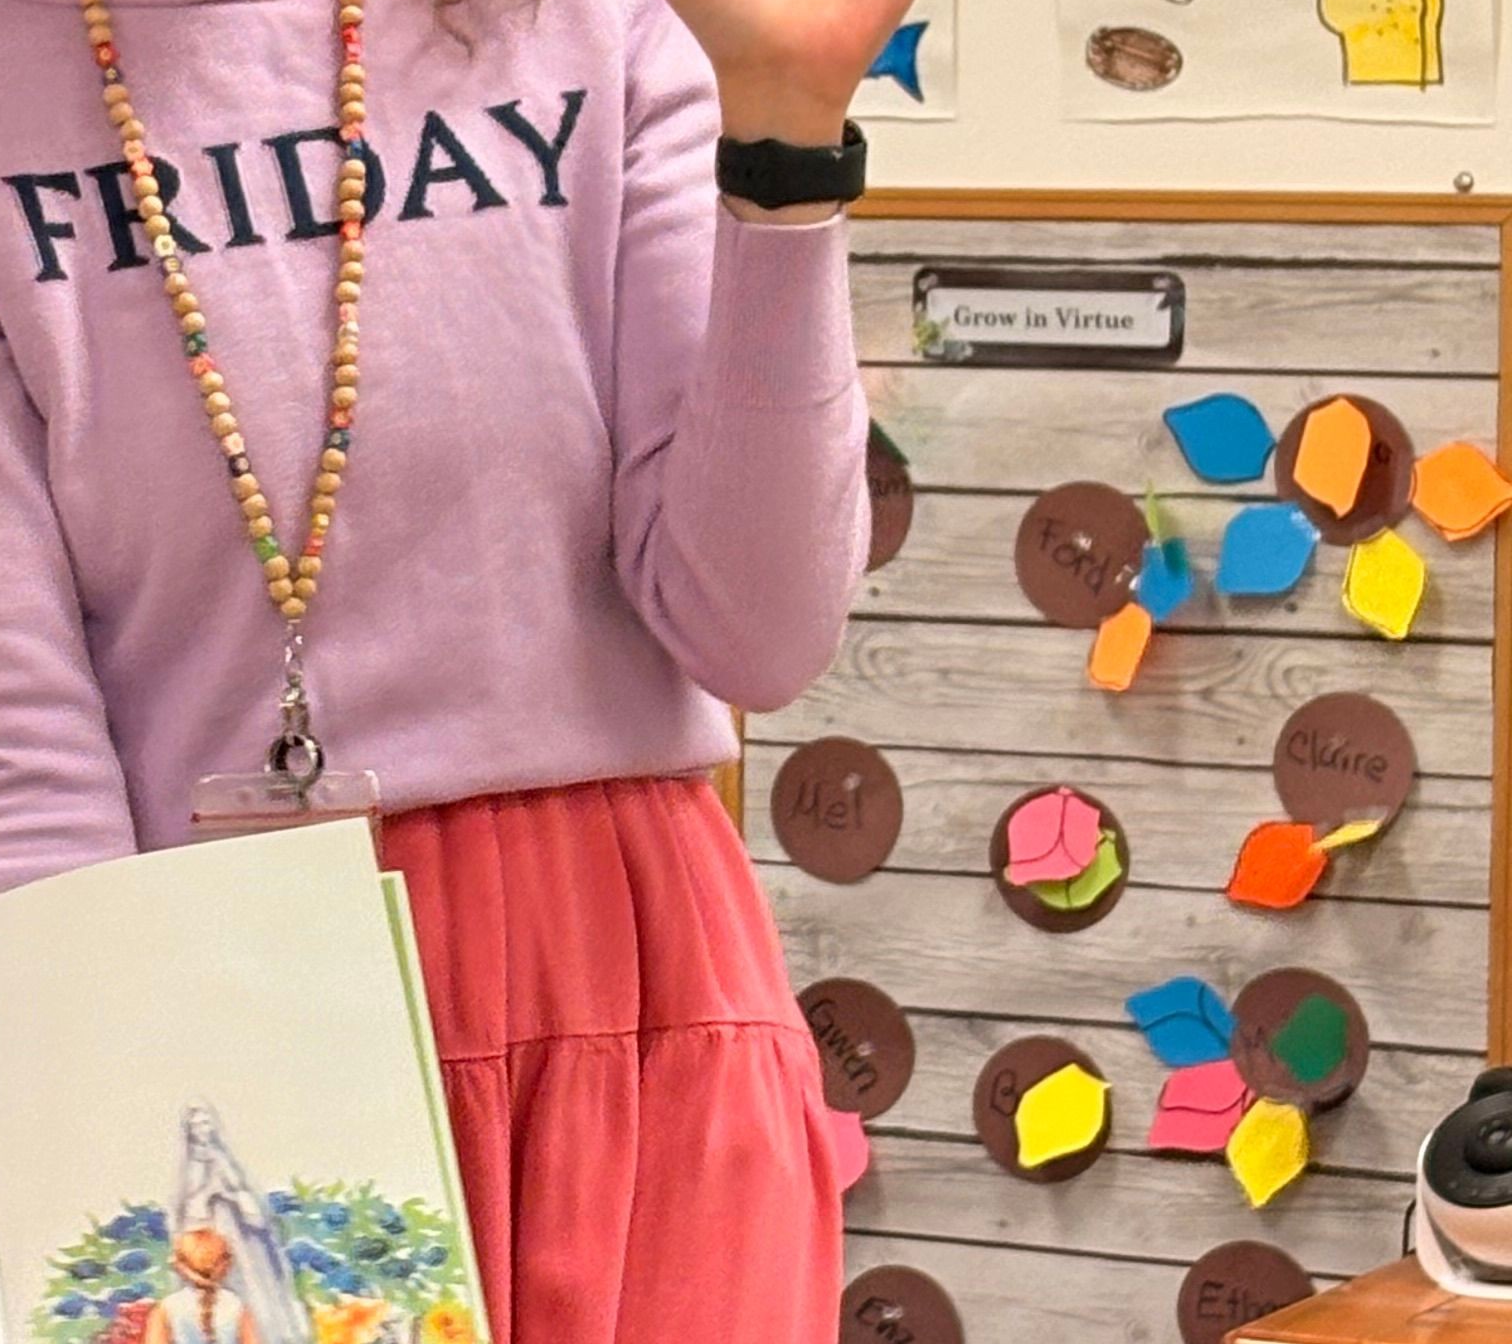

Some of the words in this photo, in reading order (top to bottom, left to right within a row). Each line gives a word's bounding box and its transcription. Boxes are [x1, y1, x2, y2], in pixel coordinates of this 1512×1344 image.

[1, 90, 587, 282] FRIDAY
[954, 306, 1017, 327] Grow
[1026, 307, 1047, 328] in
[1056, 307, 1134, 329] Virtue
[1287, 730, 1388, 783] Claire
